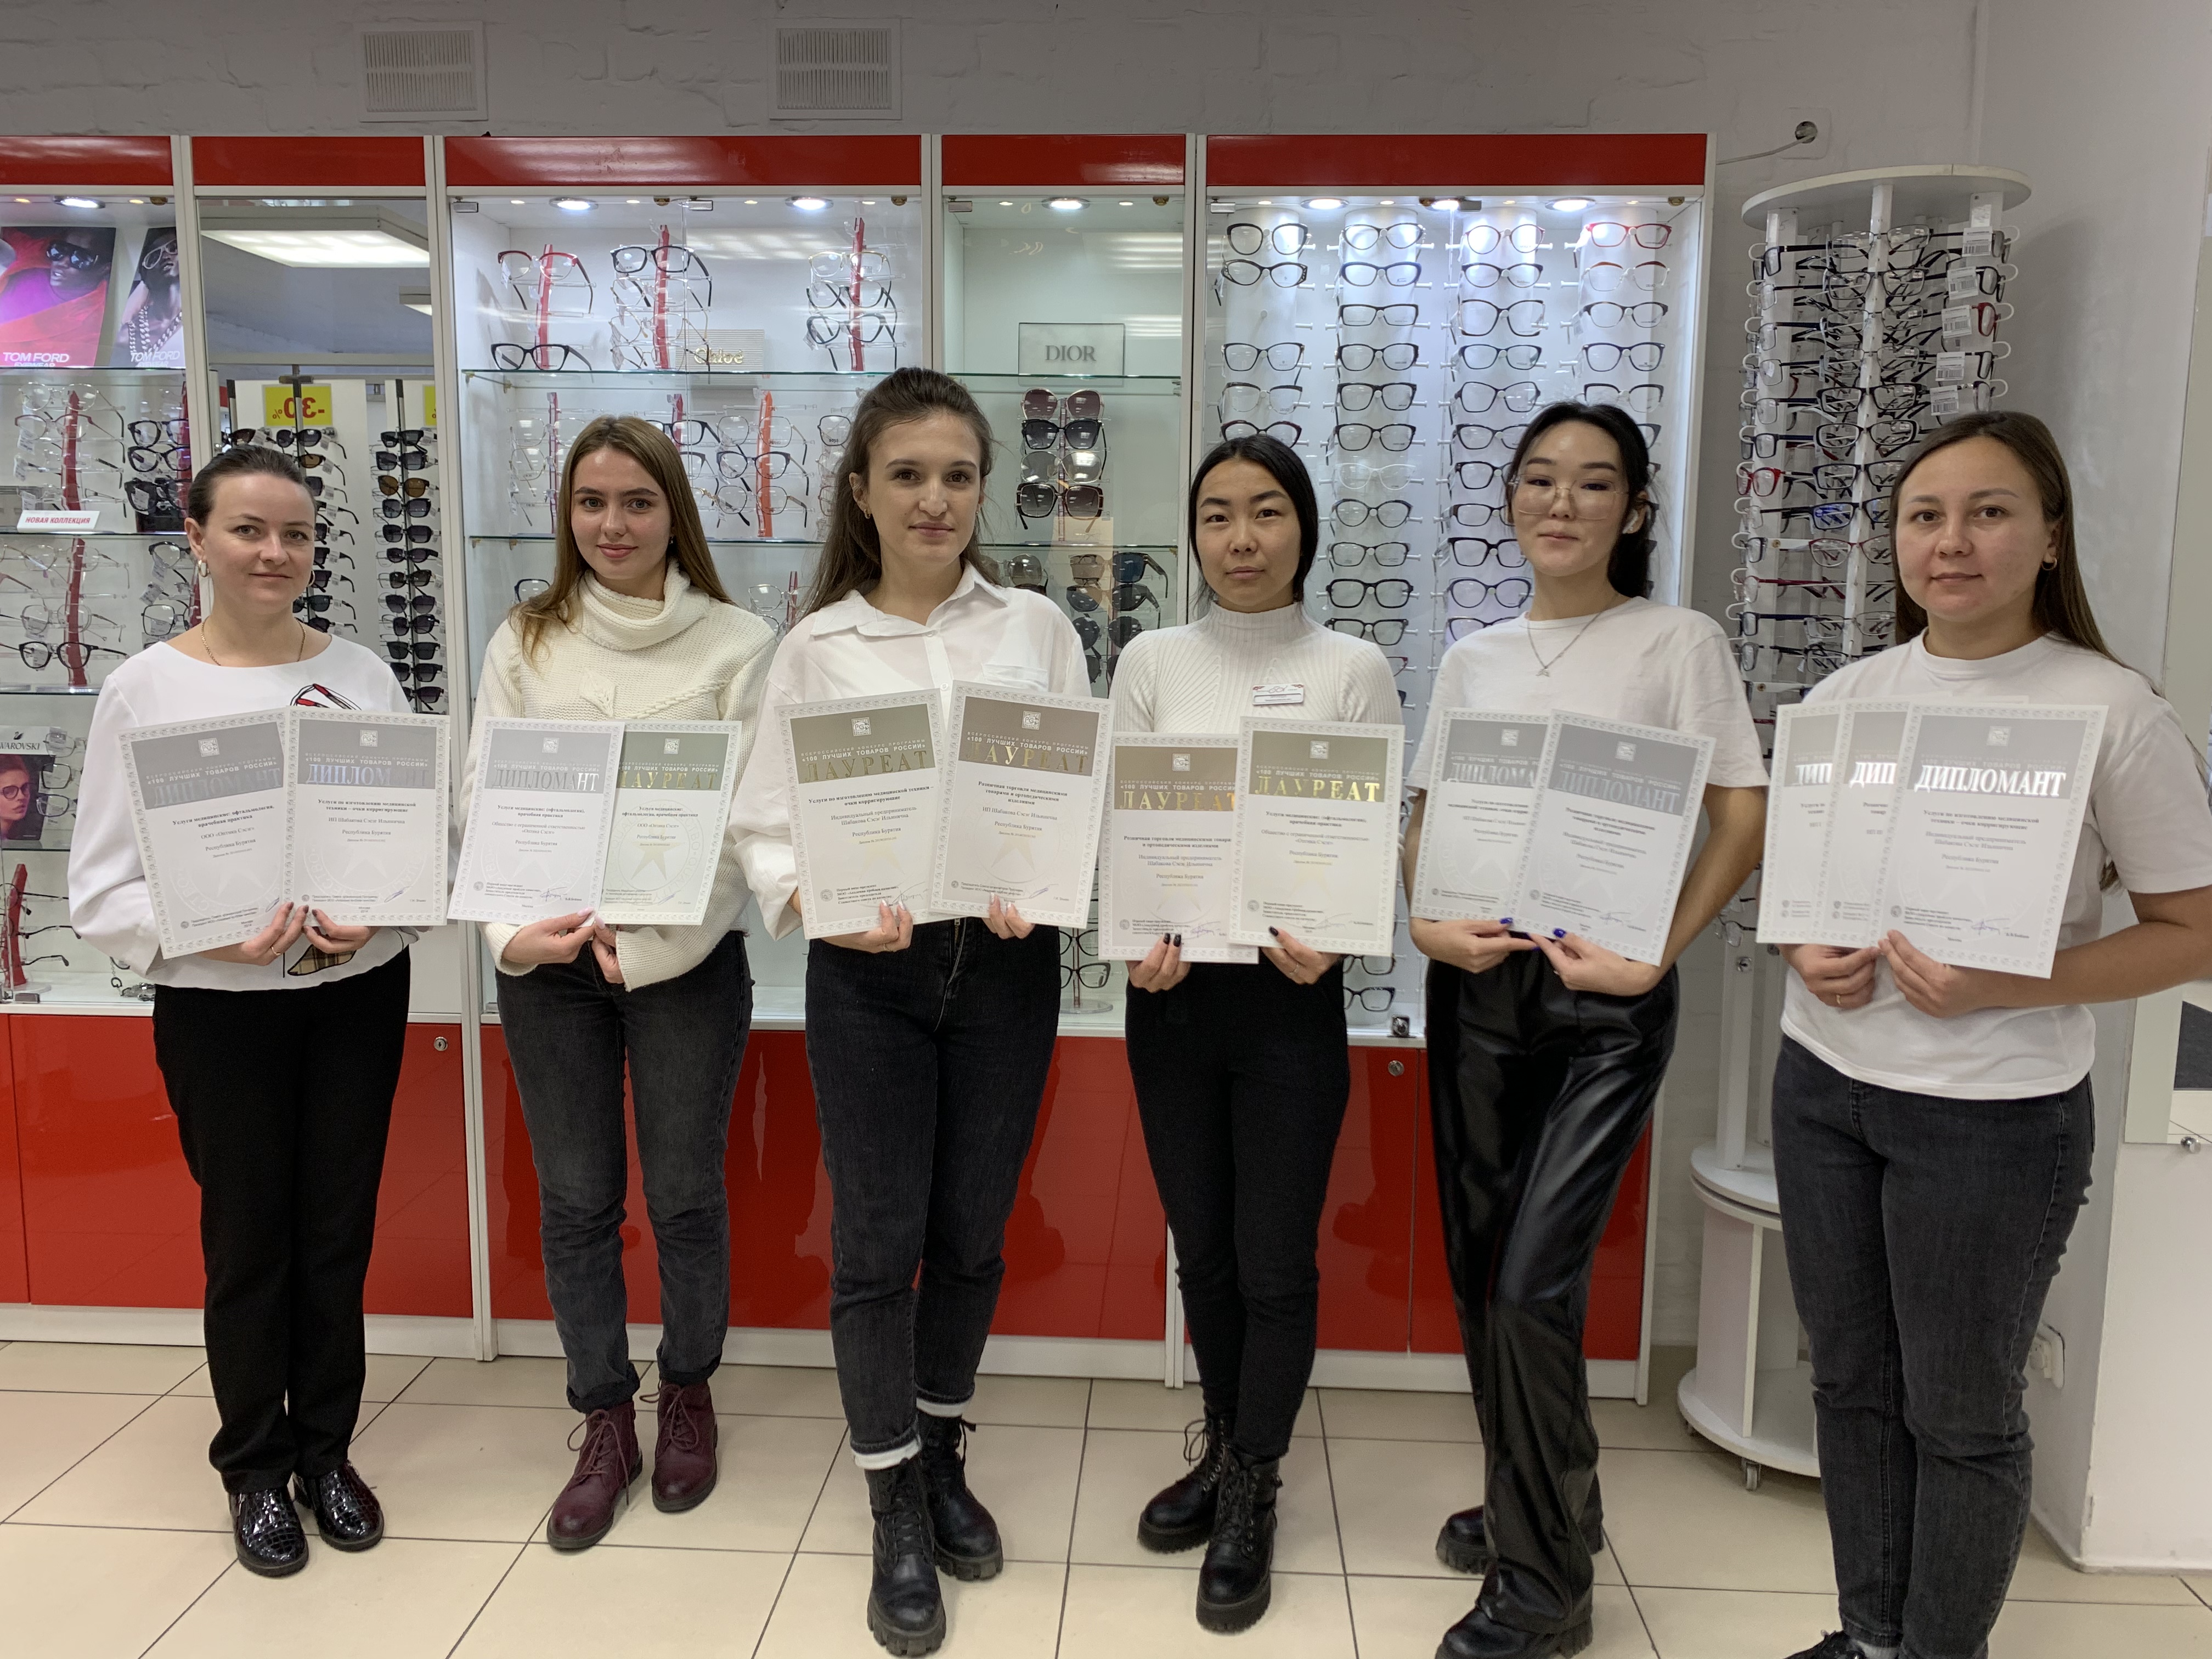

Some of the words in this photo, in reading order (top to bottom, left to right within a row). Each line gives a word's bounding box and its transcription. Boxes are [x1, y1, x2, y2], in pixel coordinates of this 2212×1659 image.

[3, 352, 33, 362] TOM
[33, 353, 70, 363] FORD
[131, 352, 153, 362] TOM
[153, 351, 180, 361] FORD
[695, 347, 744, 364] Chloé
[1045, 345, 1096, 361] DIOR
[822, 752, 851, 760] ЛУЧШИХ
[856, 747, 889, 755] ТОВАРОВ
[893, 743, 925, 751] РОССИИ»
[1019, 742, 1052, 751] ТОВАРОВ
[1056, 747, 1087, 755] РОССИИ»
[803, 749, 928, 782] ЛАУРЕАТ
[965, 741, 1088, 774] ЛАУРЕАТ
[168, 772, 201, 781] ЛУЧШИХ
[205, 766, 239, 776] ТОВАРОВ
[244, 760, 277, 770] РОССИИ»
[491, 769, 599, 793] ДИПЛОМАНТ
[1255, 776, 1379, 802] ЛАУРЕАТ
[1915, 764, 2067, 798] ДИПЛОМАНТ
[852, 829, 880, 837] Республика
[994, 821, 1022, 830] Республика
